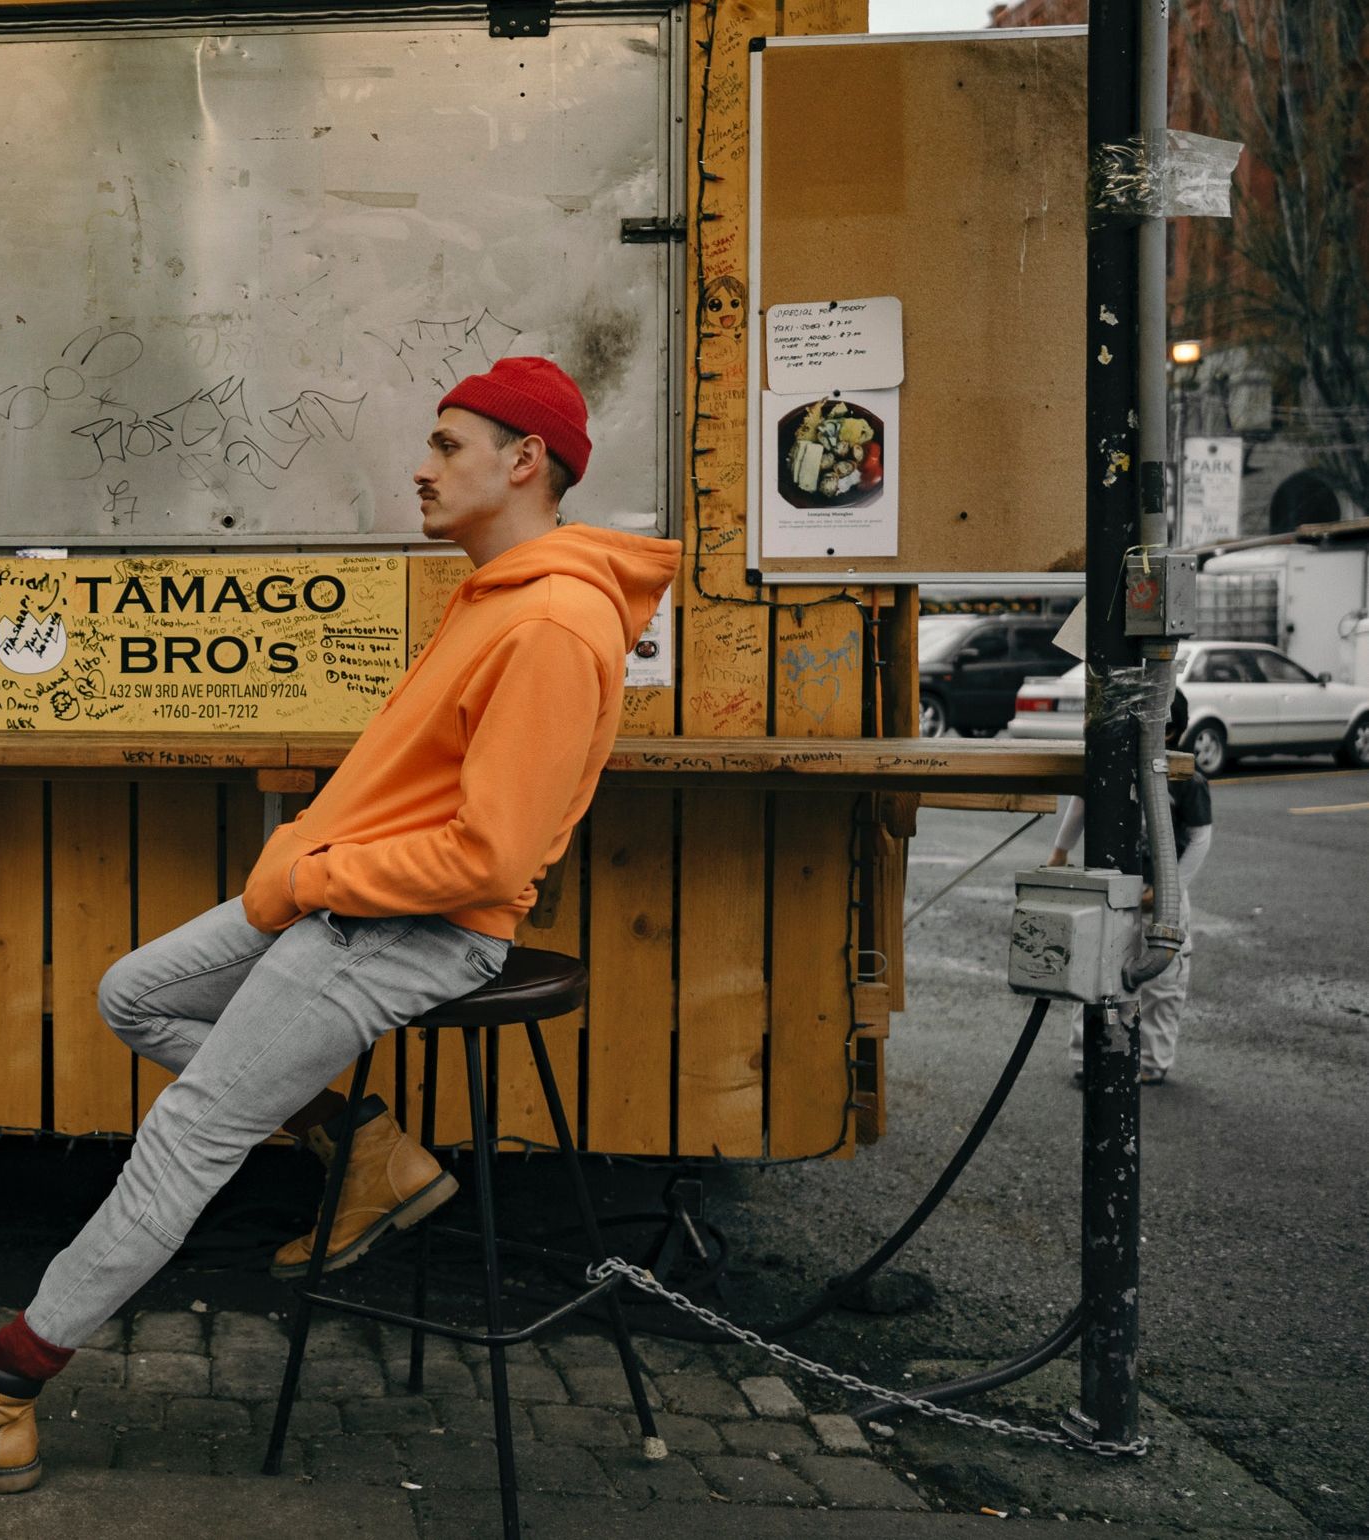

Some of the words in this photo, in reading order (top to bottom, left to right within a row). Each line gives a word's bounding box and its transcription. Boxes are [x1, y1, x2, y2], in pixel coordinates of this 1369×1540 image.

[1190, 460, 1232, 474] PARK
[75, 575, 347, 614] TAMAGO
[335, 640, 356, 651] Food
[120, 635, 299, 674] BRO's
[110, 684, 132, 698] 432
[135, 684, 153, 698] SW
[155, 684, 179, 698] 3RD
[182, 684, 205, 698] AVE
[208, 684, 268, 699] PORTLAND
[271, 684, 308, 698] 97204
[152, 704, 259, 720] +1760-201-7212
[121, 750, 154, 764] VERY
[159, 750, 214, 766] FRIENDLY
